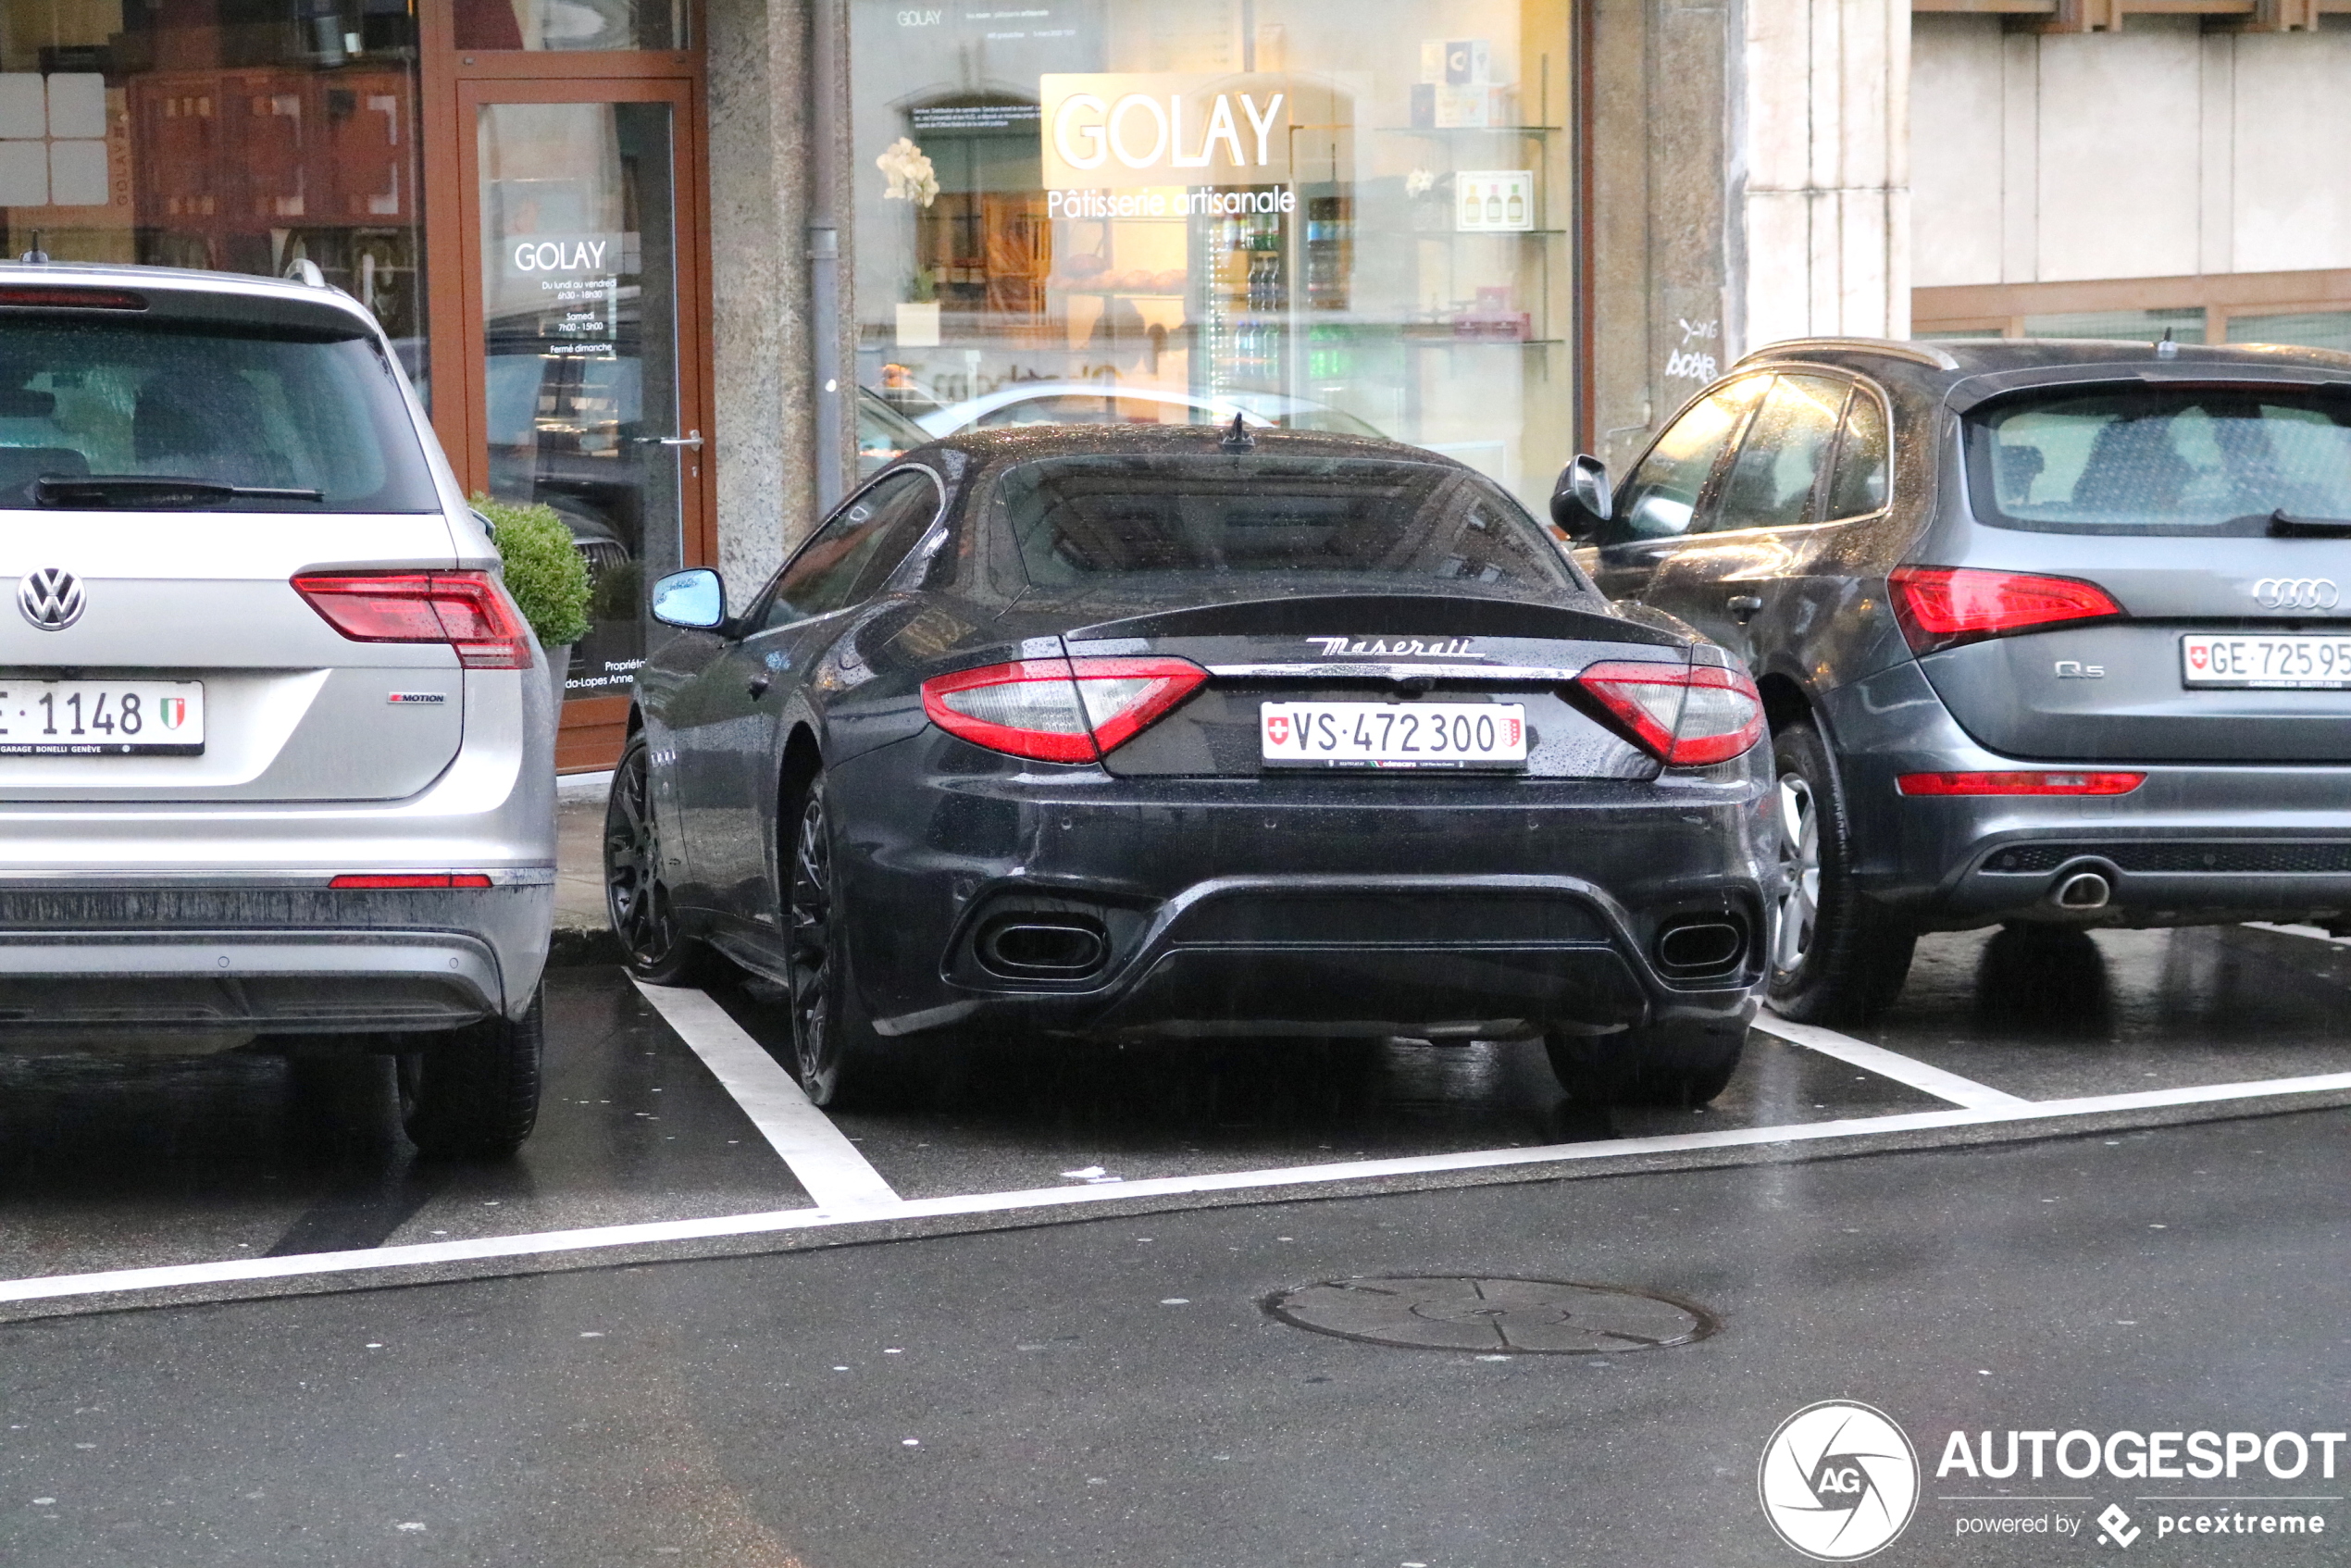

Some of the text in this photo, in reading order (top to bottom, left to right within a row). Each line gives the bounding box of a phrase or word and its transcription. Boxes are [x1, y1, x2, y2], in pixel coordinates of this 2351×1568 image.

[896, 9, 942, 26] GOLAY
[1052, 92, 1284, 169] GOLAY
[1047, 185, 1296, 218] Pâtisserie artisanale
[515, 241, 606, 271] GOLAY
[542, 281, 553, 290] Du
[554, 280, 571, 290] lundi
[566, 312, 594, 320] Samedi
[550, 343, 613, 354] Fermé dimanche
[1306, 636, 1486, 659] Maserati
[604, 658, 648, 672] Propriéta
[2055, 660, 2105, 678] Q5
[609, 674, 634, 685] Anne
[71, 744, 101, 753] GENÈVE
